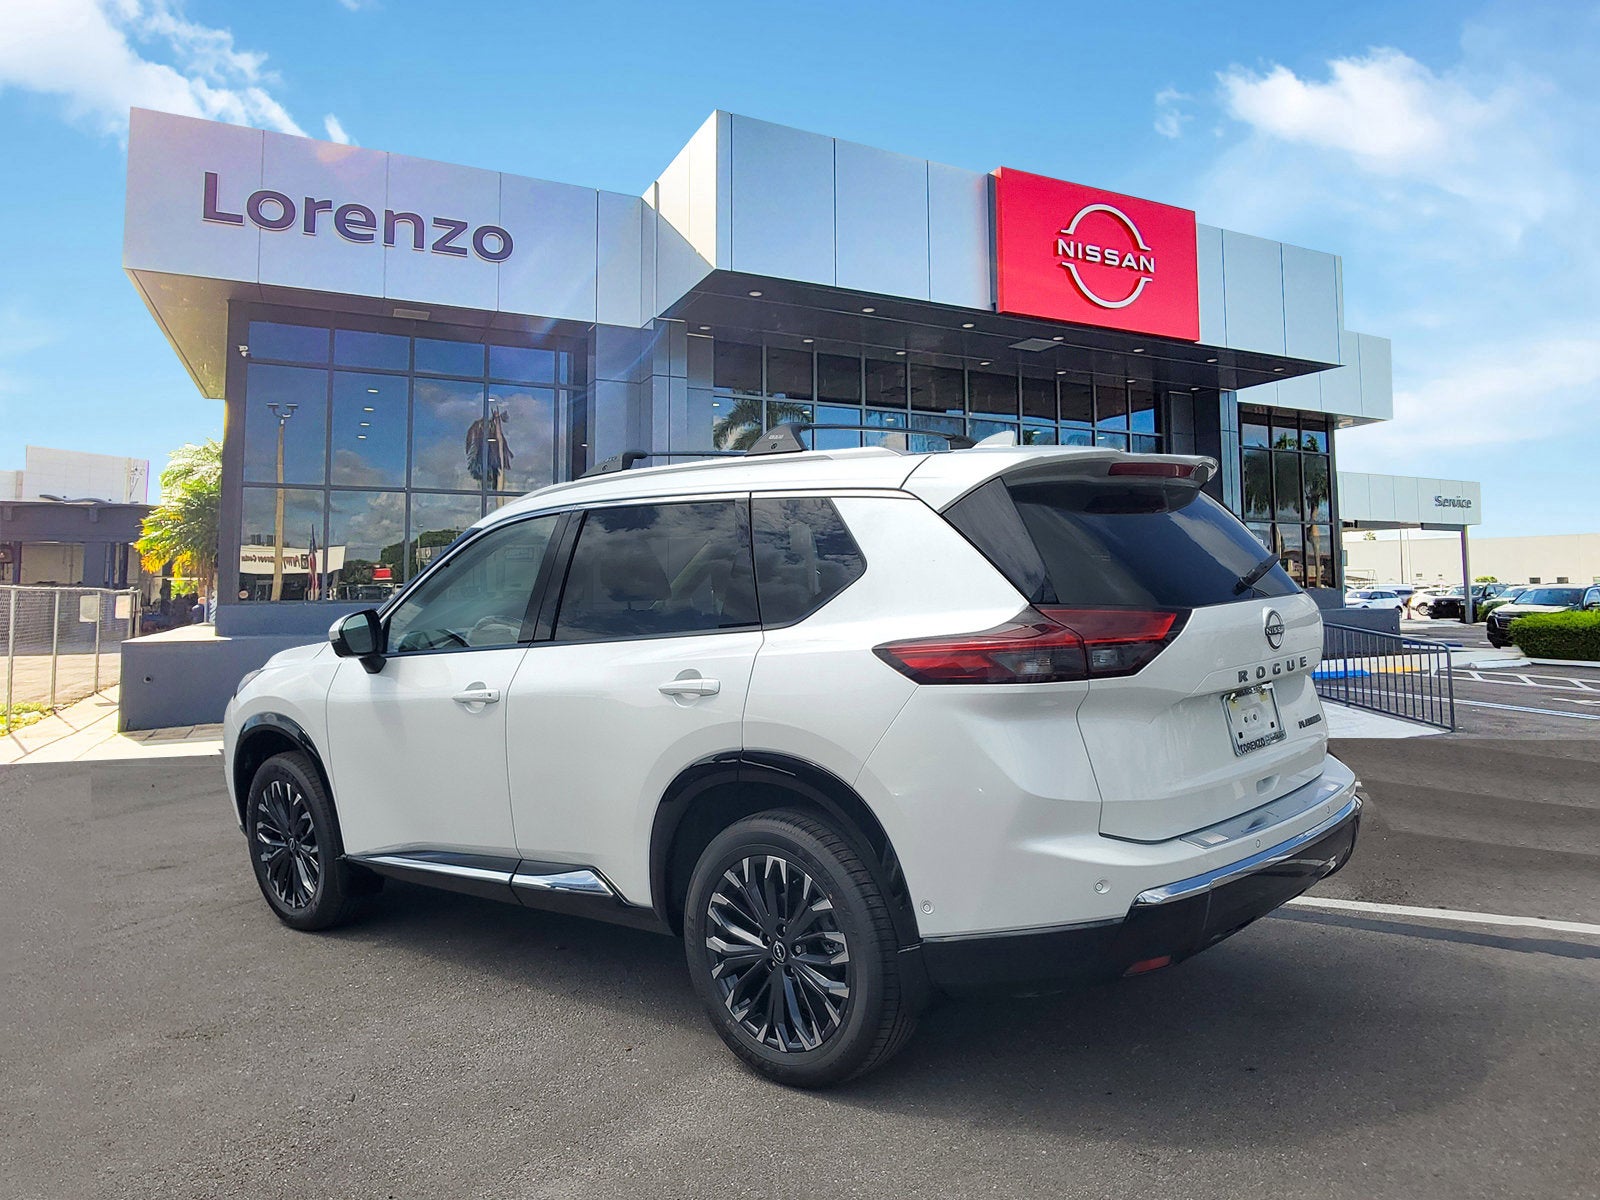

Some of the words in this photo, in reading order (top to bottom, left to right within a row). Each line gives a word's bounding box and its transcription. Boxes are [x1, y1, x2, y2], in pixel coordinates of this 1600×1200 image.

[203, 171, 514, 263] Lorenzo
[1057, 238, 1155, 273] NISSAN
[1434, 495, 1472, 508] Service
[1238, 656, 1307, 683] ROGUE
